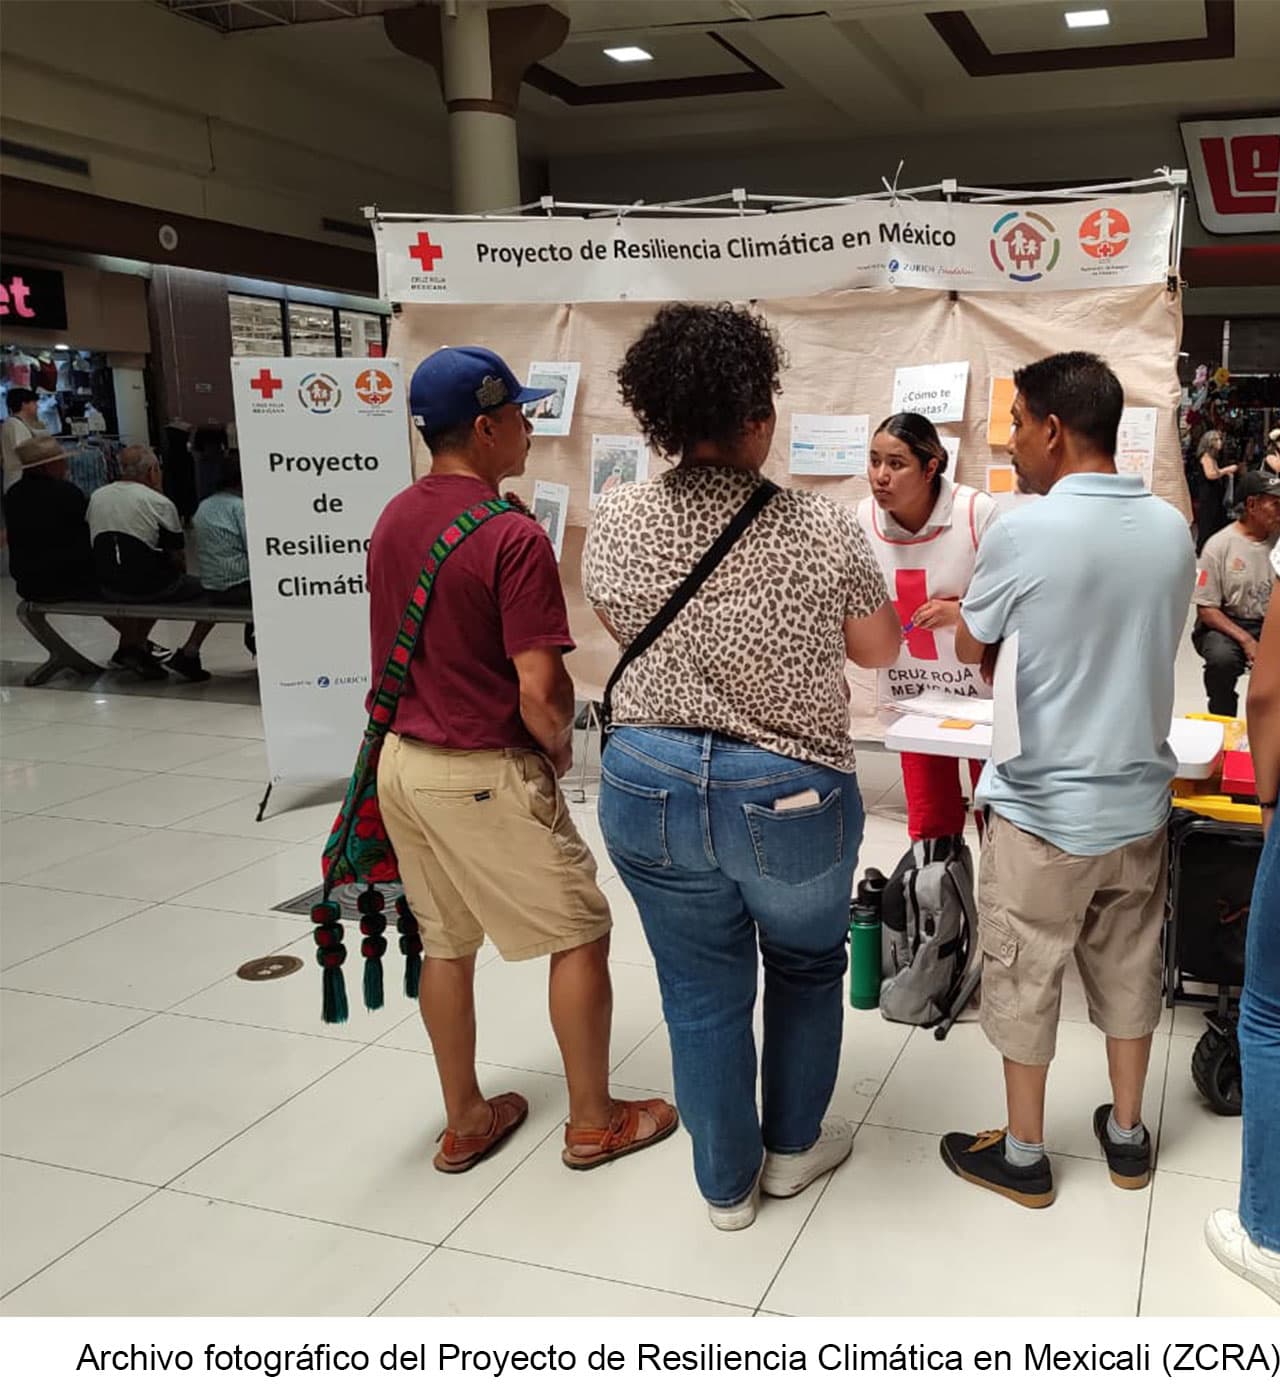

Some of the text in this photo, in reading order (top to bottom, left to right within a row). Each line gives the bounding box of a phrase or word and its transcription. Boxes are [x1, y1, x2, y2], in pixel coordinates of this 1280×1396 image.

[476, 222, 956, 267] Proyecto de Resiliencia Climática en México
[940, 389, 951, 398] te
[269, 453, 379, 476] Proyecto
[313, 494, 343, 513] de
[888, 667, 974, 683] CRUZ ROJA
